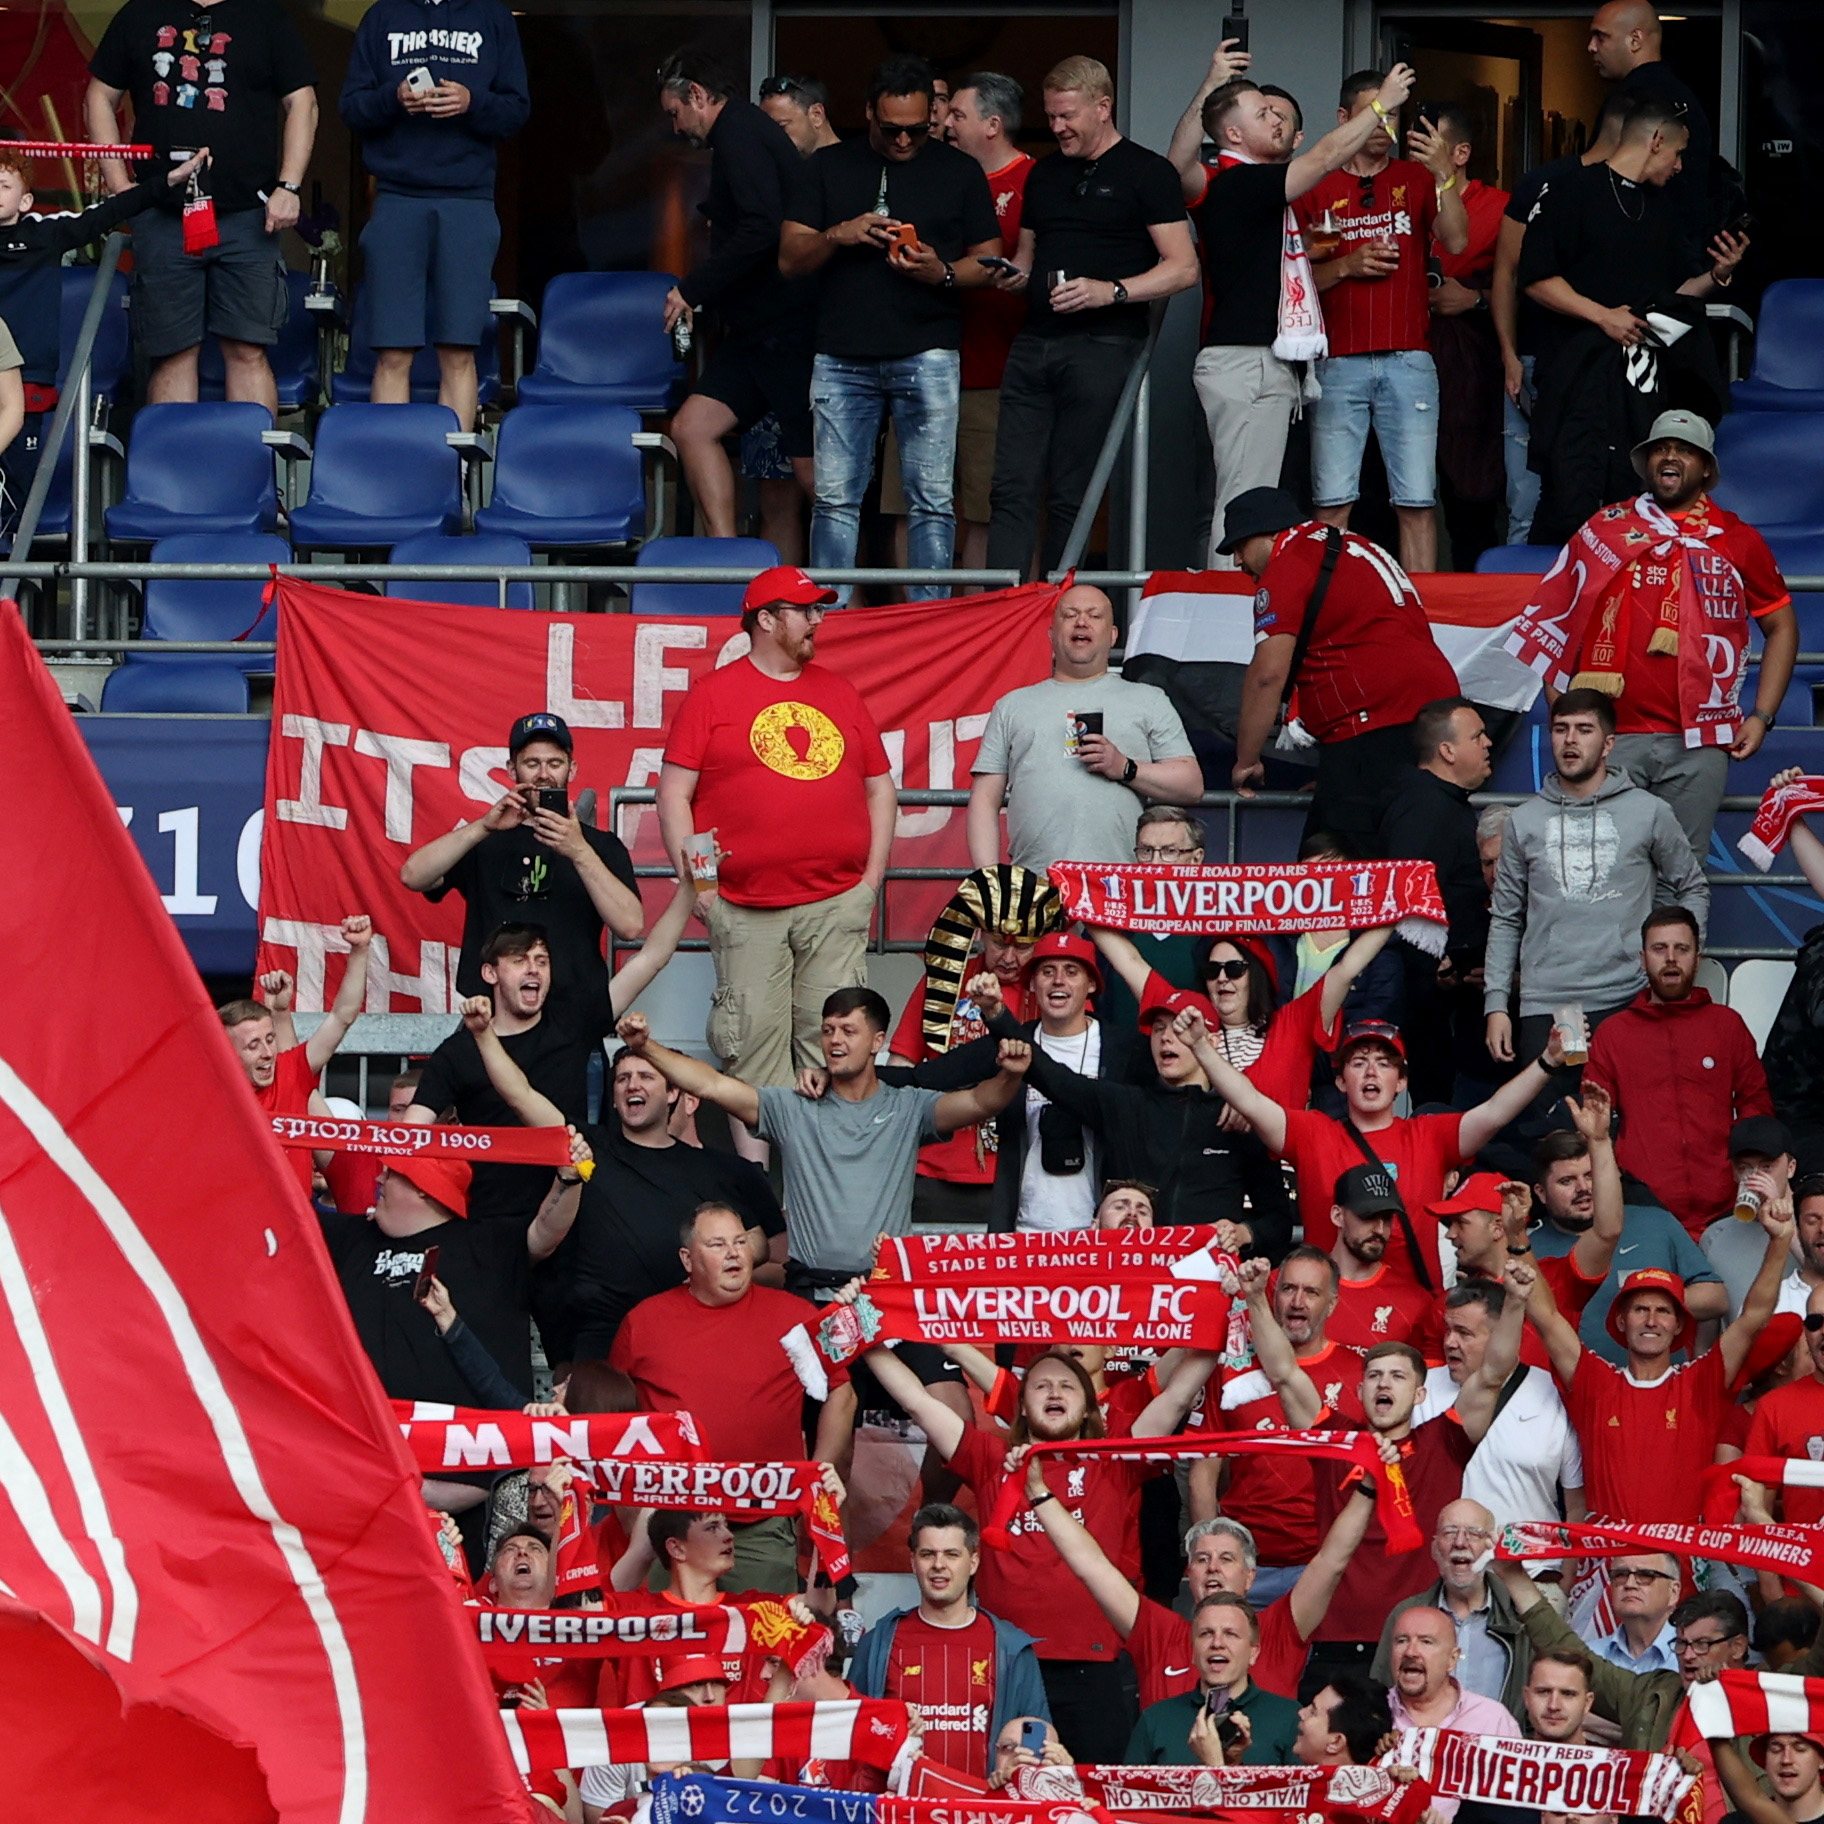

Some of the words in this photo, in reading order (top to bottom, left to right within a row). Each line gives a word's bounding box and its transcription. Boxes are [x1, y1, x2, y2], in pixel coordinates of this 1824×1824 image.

[387, 29, 483, 60] THRASHER
[1198, 866, 1235, 876] ROAD
[1239, 866, 1257, 876] TO
[1262, 865, 1308, 876] PARIS
[1132, 878, 1343, 915] LIVERPOOL
[1129, 918, 1202, 931] EUROPEAN
[1206, 920, 1233, 932] CUP
[1236, 919, 1275, 931] FINAL
[1278, 916, 1345, 930] 28/05/2022
[272, 1118, 360, 1140] SPION
[367, 1126, 431, 1153] KOP
[441, 1133, 491, 1149] 1906
[923, 1232, 1017, 1254] PARIS
[1025, 1230, 1109, 1248] FINAL
[1120, 1224, 1195, 1246] 2022
[929, 1257, 986, 1273] STADE
[996, 1256, 1017, 1268] DE
[1027, 1253, 1097, 1267] FRANCE
[1122, 1253, 1142, 1265] 28
[914, 1285, 1130, 1321] LIVERPOOL
[1149, 1285, 1197, 1322] FC
[919, 1322, 983, 1338] YOU'LL
[997, 1321, 1052, 1337] NEVER
[1068, 1321, 1116, 1337] WALK
[1133, 1323, 1192, 1339] ALONE
[634, 1494, 687, 1504] WALK
[695, 1496, 722, 1506] ON
[1699, 1530, 1732, 1549] CUP
[1738, 1533, 1812, 1566] WINNERS
[1497, 1740, 1551, 1757] MIGHTY
[1556, 1747, 1593, 1759] REDS
[1439, 1734, 1632, 1813] LIVERPOOL
[727, 1790, 806, 1817] 2022
[1103, 1784, 1133, 1809] ON
[1139, 1792, 1192, 1808] WALK
[1224, 1791, 1253, 1808] ON
[1257, 1784, 1309, 1808] WALK
